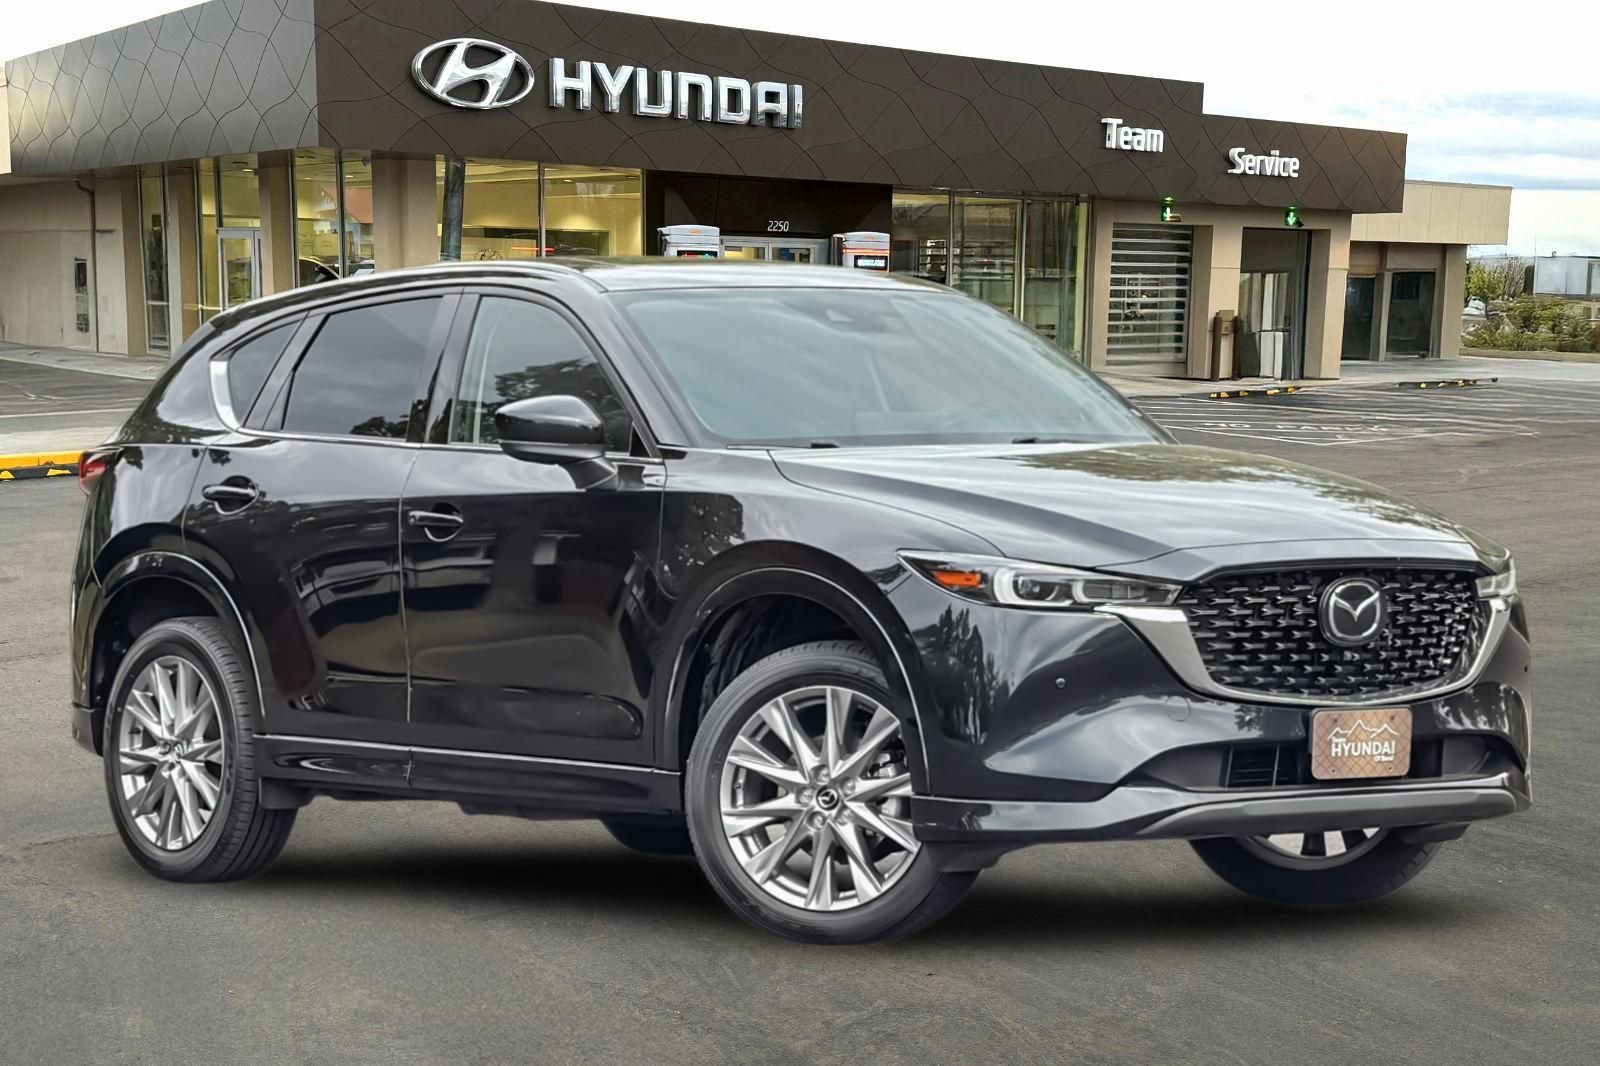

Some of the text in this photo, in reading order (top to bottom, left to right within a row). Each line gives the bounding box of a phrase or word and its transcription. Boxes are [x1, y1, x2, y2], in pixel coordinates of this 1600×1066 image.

[549, 57, 803, 129] HYUNDAI
[1101, 117, 1164, 153] Team
[1227, 147, 1301, 178] Service
[767, 220, 790, 232] 2250
[1331, 740, 1396, 757] HYUNDAI
